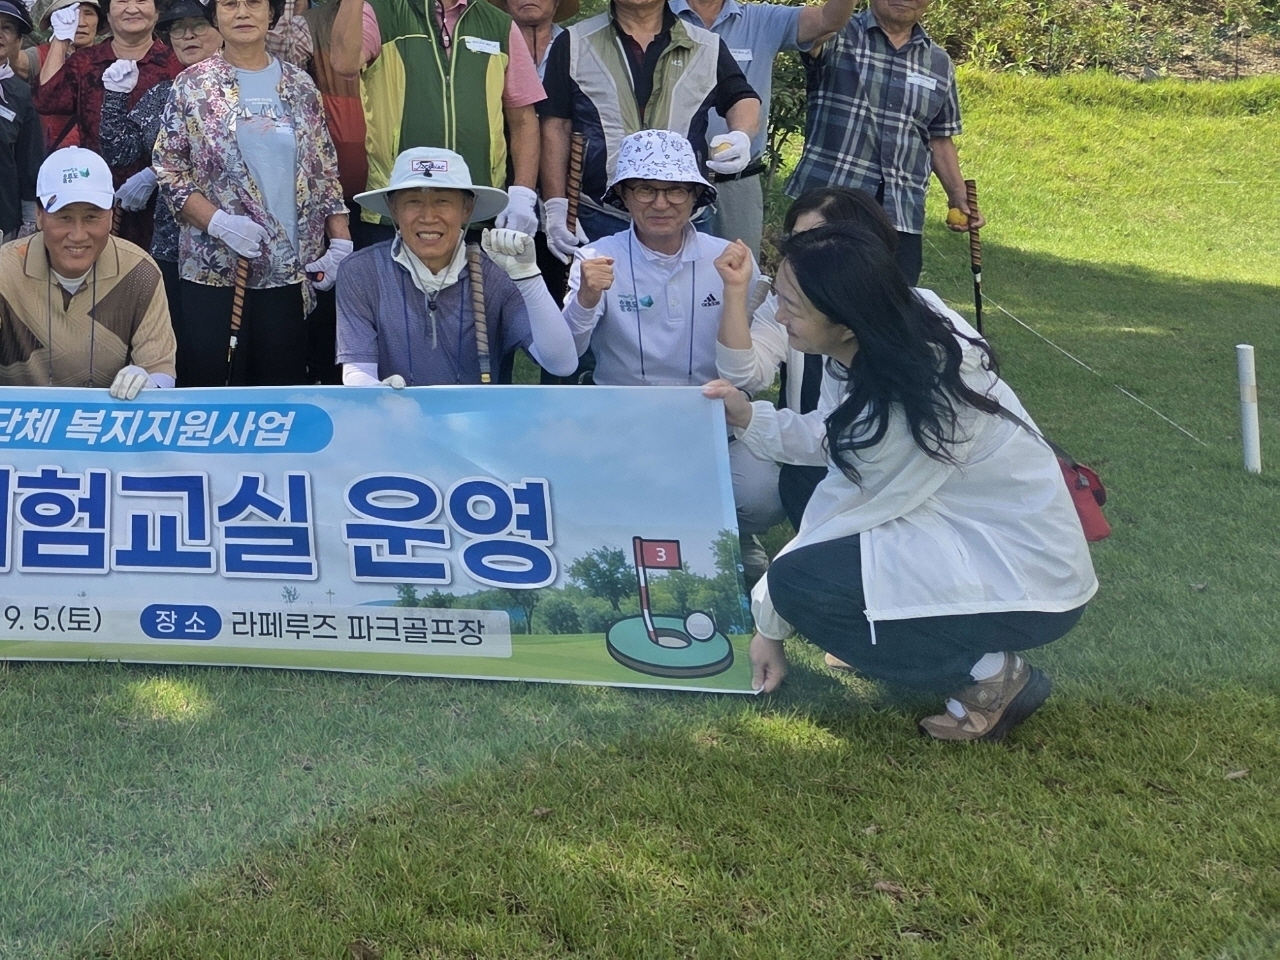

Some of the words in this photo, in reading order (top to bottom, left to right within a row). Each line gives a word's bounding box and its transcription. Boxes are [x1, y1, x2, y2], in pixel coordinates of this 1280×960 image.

[65, 409, 296, 447] 복지지원사업
[343, 474, 557, 588] 운영
[655, 547, 667, 562] 3
[4, 605, 24, 631] 9.
[33, 605, 102, 633] 5.(토)
[154, 609, 207, 634] 장소
[231, 611, 338, 640] 라페루즈
[347, 614, 485, 646] 파크골프장
